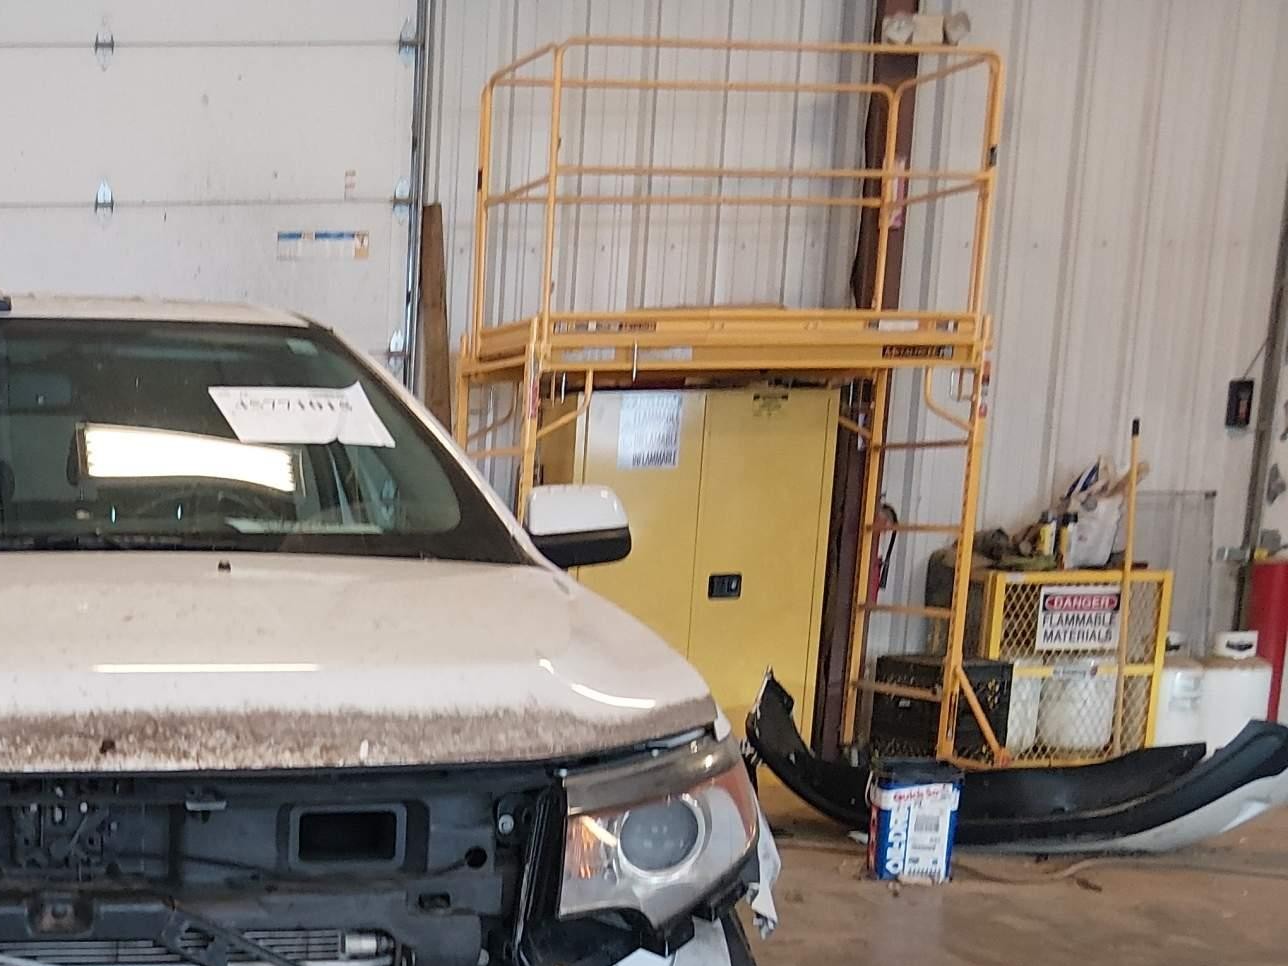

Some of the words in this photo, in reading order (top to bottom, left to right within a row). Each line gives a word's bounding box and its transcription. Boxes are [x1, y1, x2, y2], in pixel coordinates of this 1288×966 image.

[1052, 595, 1110, 610] DANGER
[1042, 612, 1113, 627] FLAMMABLE
[1042, 629, 1113, 643] MATERIALS
